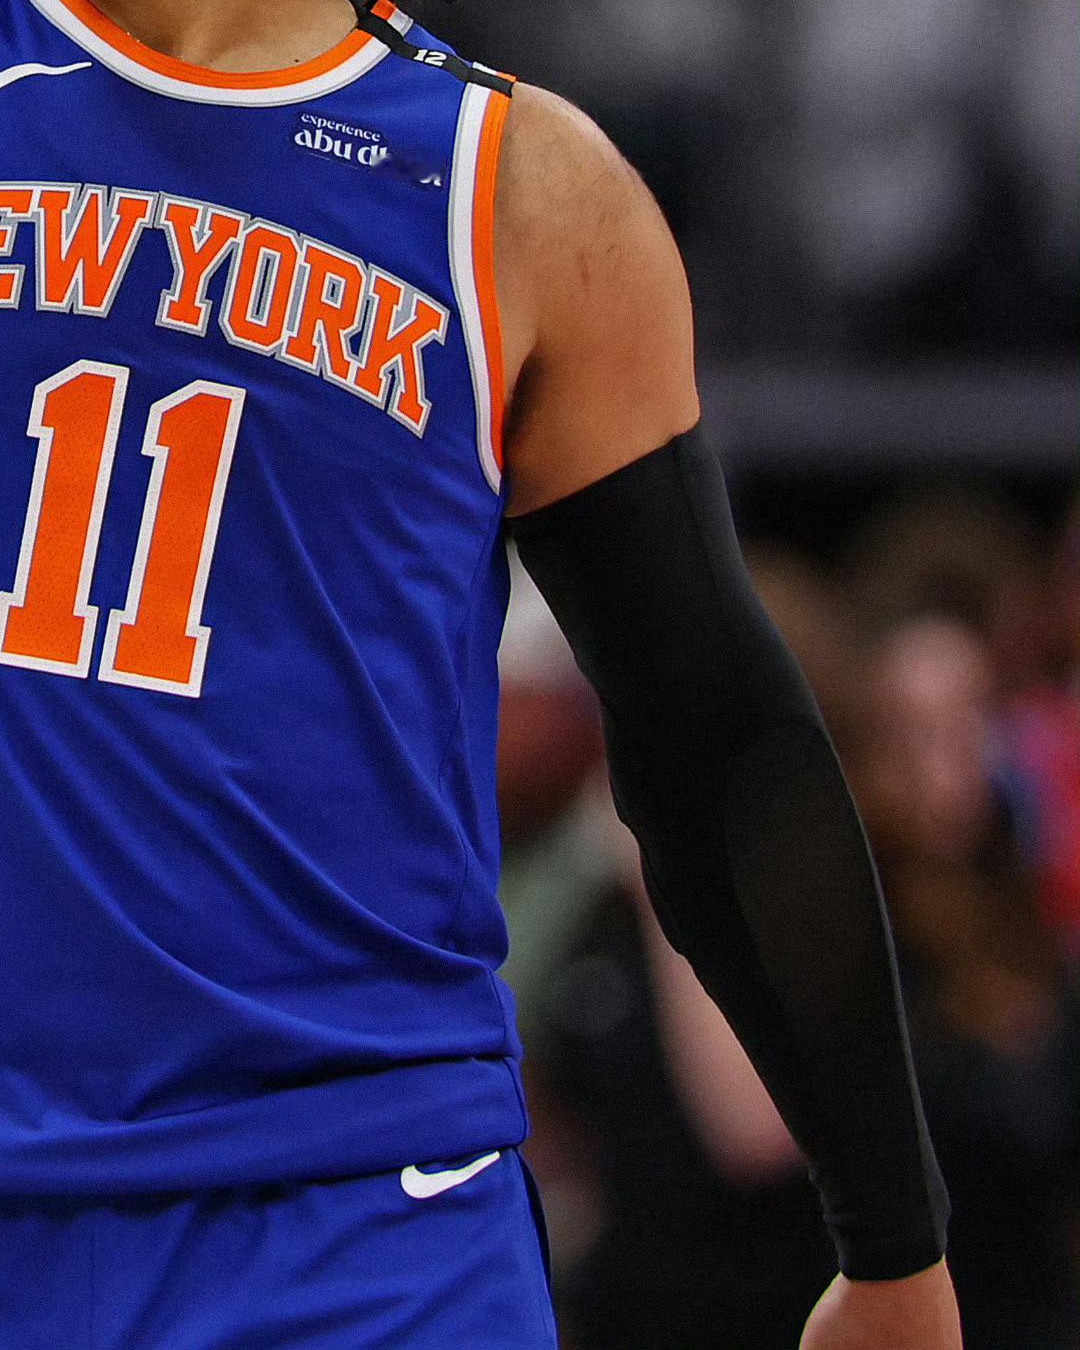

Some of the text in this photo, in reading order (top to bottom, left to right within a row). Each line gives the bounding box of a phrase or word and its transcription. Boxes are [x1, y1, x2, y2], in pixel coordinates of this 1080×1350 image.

[413, 49, 447, 67] 12
[300, 113, 381, 142] experience
[294, 129, 352, 160] abu
[154, 191, 451, 438] YORK
